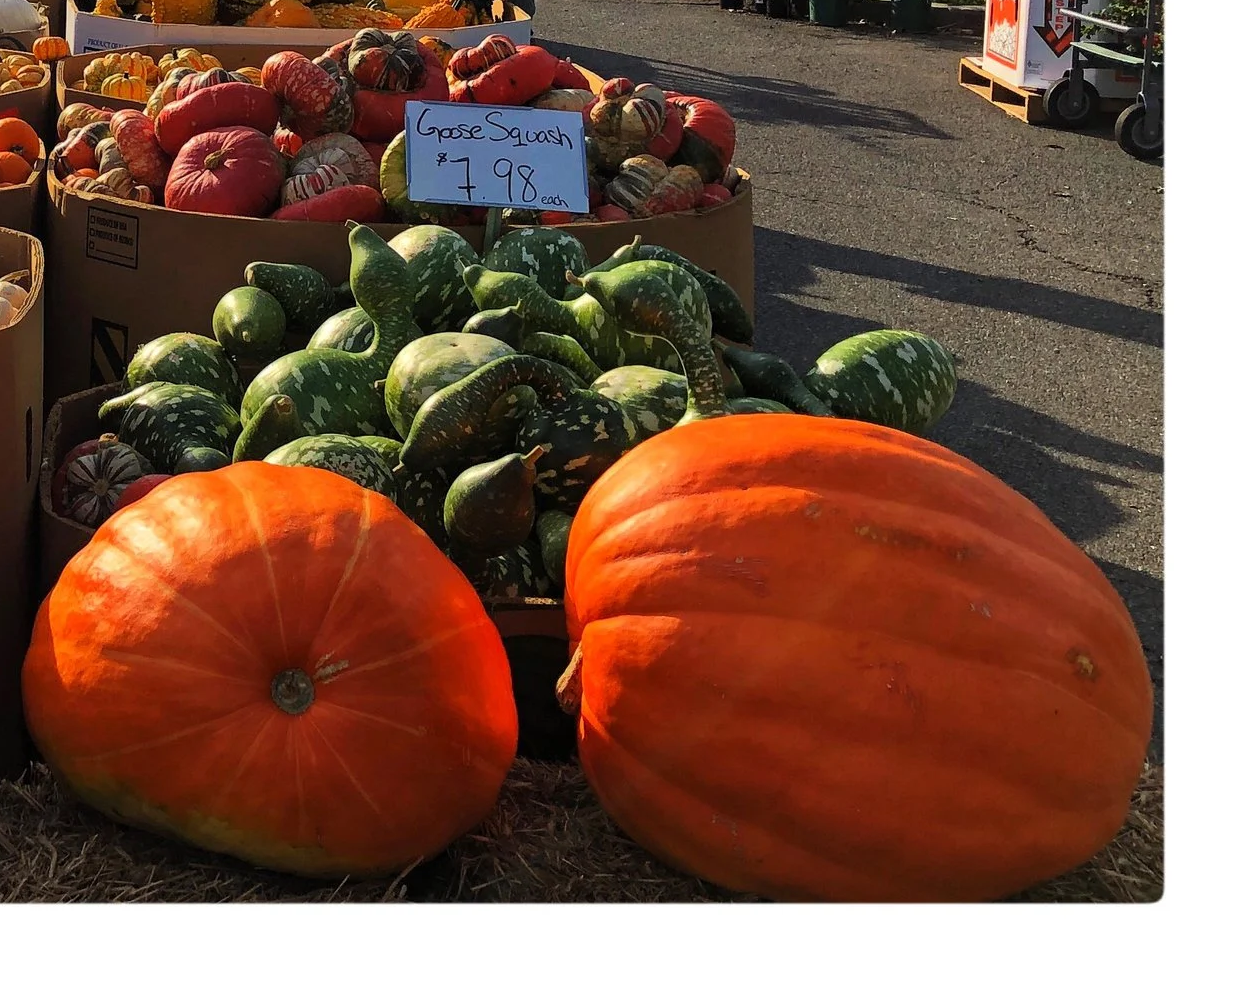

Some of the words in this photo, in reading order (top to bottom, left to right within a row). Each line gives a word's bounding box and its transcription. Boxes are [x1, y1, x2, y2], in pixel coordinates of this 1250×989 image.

[416, 108, 485, 143] Goose
[485, 111, 573, 149] Squash
[436, 152, 537, 203] $7.98
[541, 195, 569, 208] each
